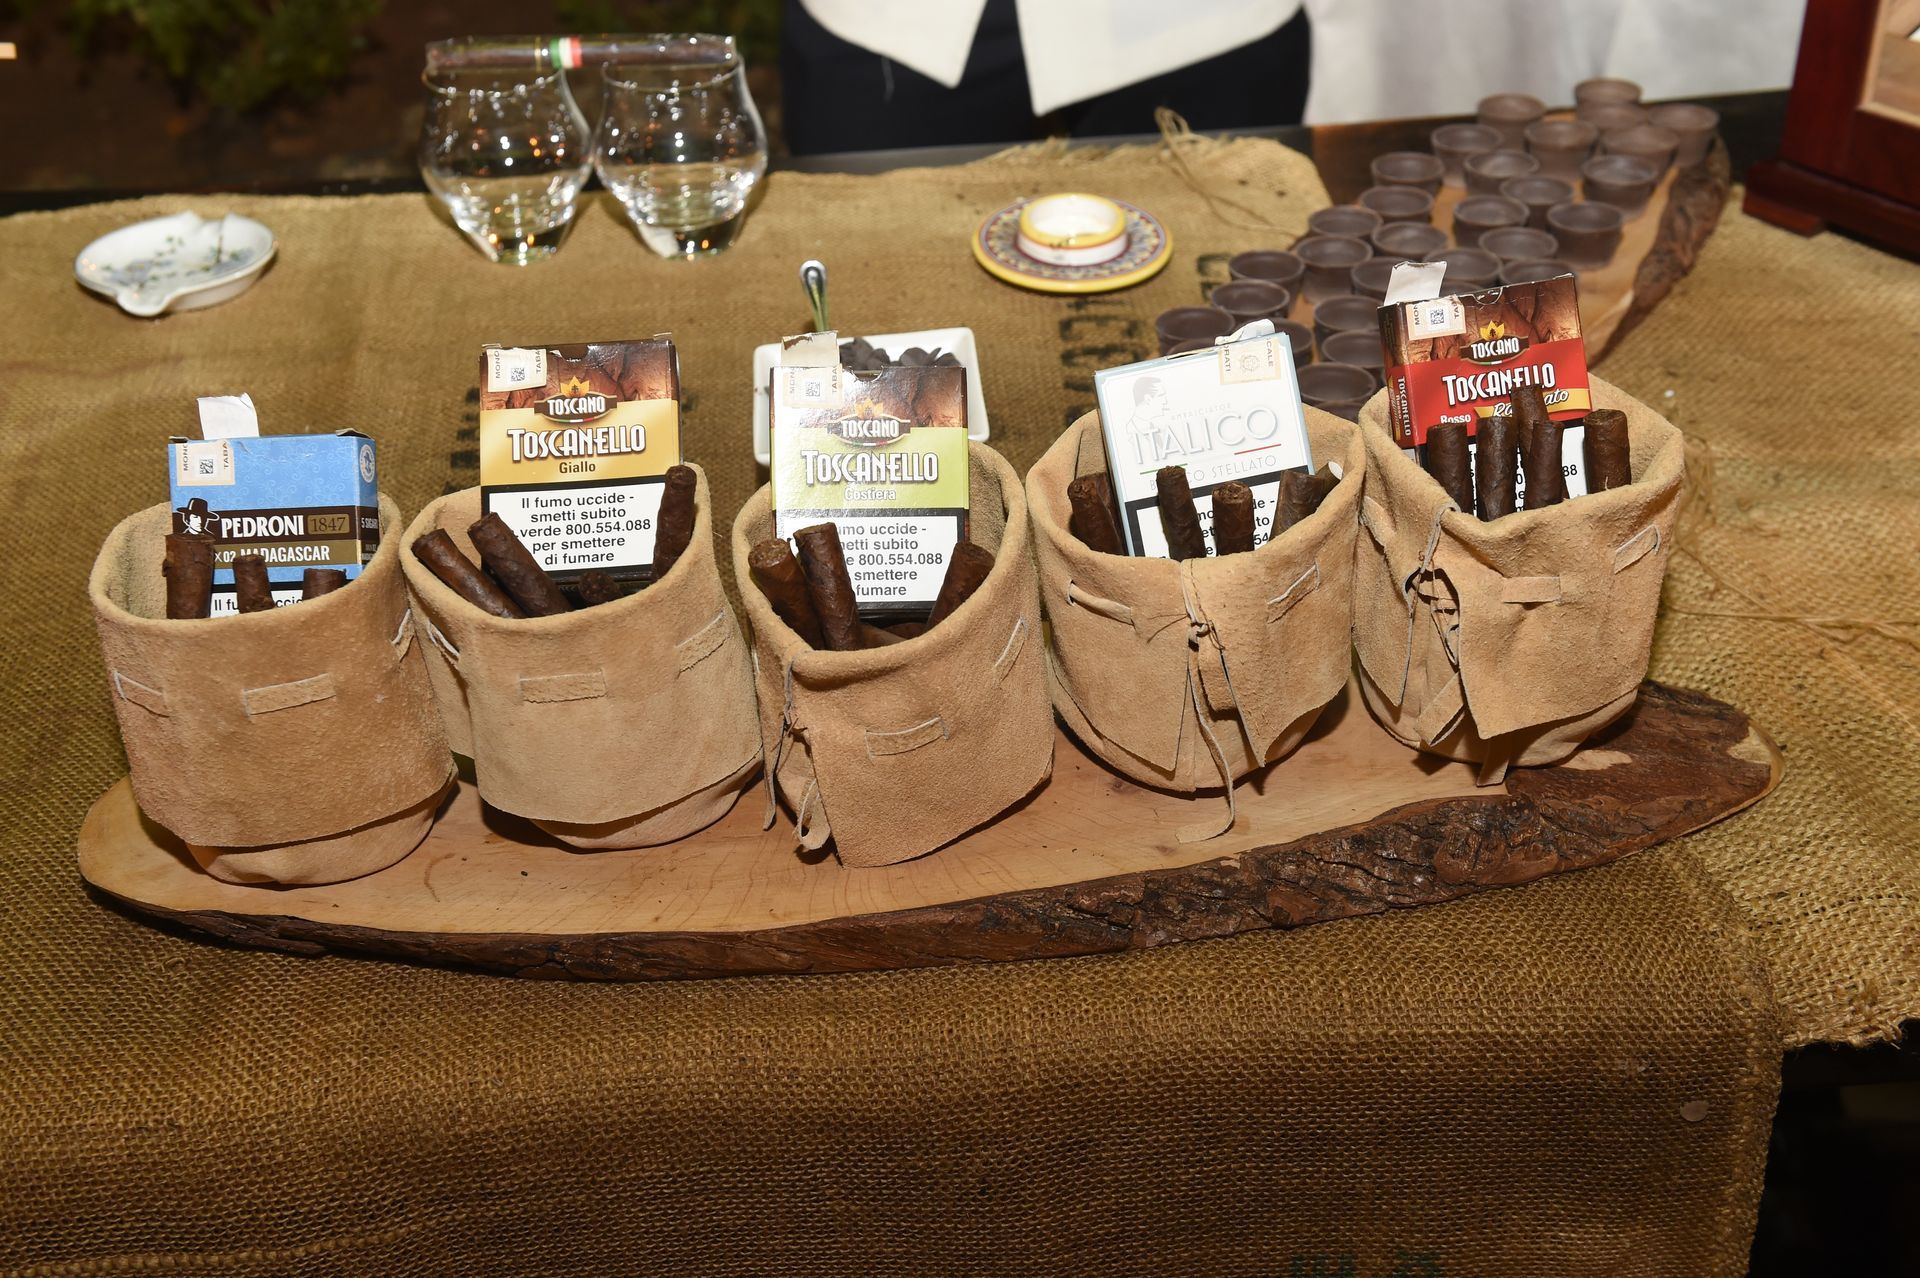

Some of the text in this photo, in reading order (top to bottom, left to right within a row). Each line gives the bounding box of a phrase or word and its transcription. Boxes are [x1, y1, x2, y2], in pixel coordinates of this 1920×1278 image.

[1471, 337, 1520, 359] TOSCANO
[547, 396, 606, 416] TOSCANO
[1397, 376, 1412, 436] TOSCANELLO
[842, 419, 900, 439] TOSCANO
[1135, 406, 1279, 465] ITALICO
[507, 424, 646, 462] TOSCANELLO
[559, 461, 597, 474] Giallo
[801, 450, 939, 487] TOSCANELLO
[1212, 455, 1277, 479] STELLATO
[535, 496, 572, 509] fumo
[577, 493, 626, 507] uccide
[844, 487, 897, 501] Costiera
[531, 507, 626, 523] smetti subito
[221, 515, 347, 539] PEDRONI 1847
[514, 519, 651, 539] .verde 800.554.088
[839, 524, 865, 536] mo
[870, 523, 918, 536] uccide
[532, 536, 626, 555] per smettere
[840, 538, 919, 551] etti subito
[545, 551, 615, 566] di fumare
[858, 553, 943, 566] 800.554.088
[854, 569, 918, 581] smettere
[856, 584, 907, 596] fumare
[226, 598, 240, 611] fu
